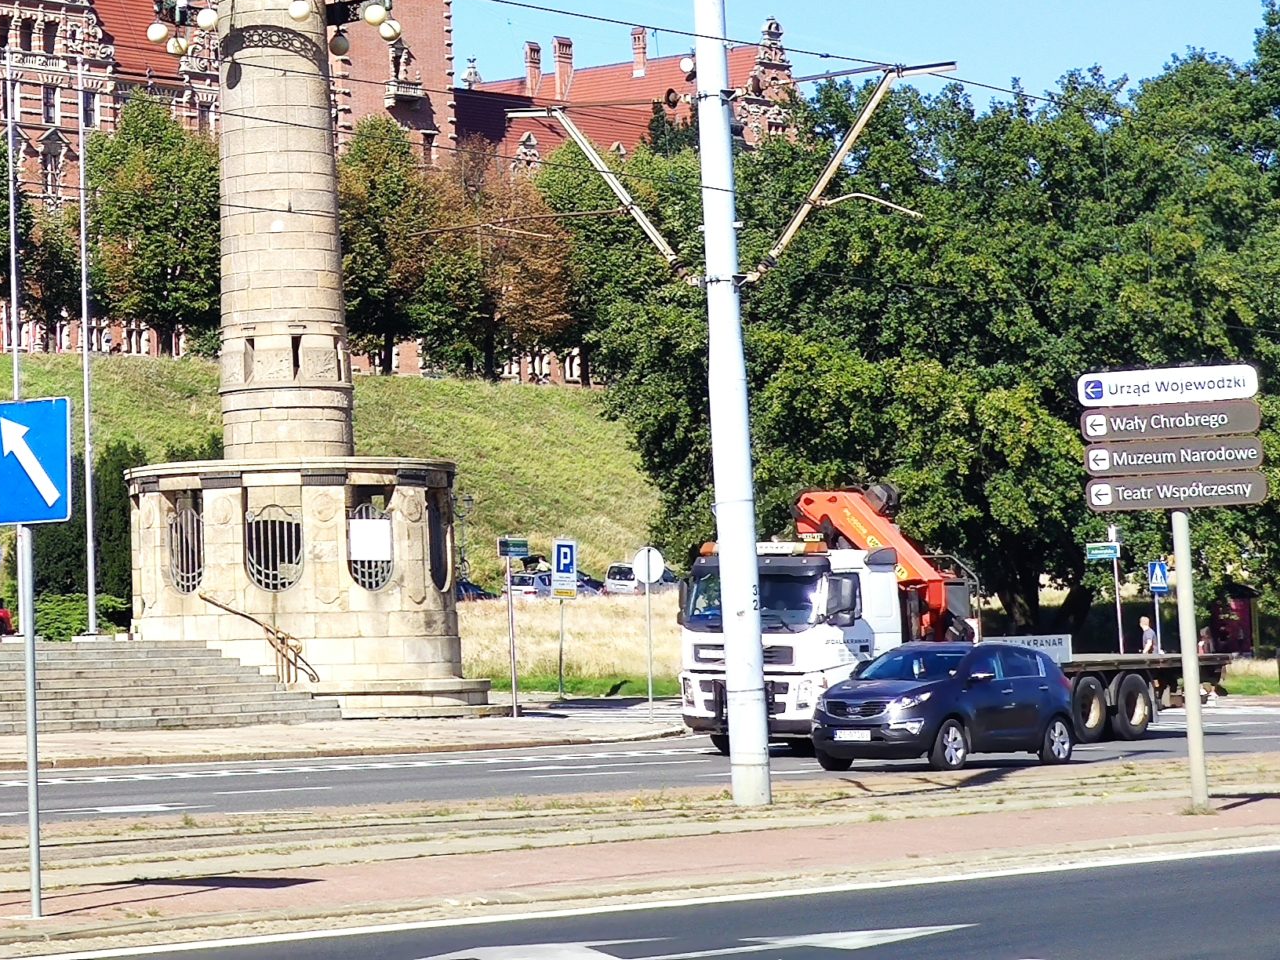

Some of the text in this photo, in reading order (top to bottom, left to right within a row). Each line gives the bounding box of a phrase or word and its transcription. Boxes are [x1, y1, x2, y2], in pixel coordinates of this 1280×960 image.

[1108, 381, 1150, 396] Urząd
[1110, 412, 1228, 433] Wały Chrobrego
[1112, 447, 1258, 466] Muzeum Narodowe
[1116, 482, 1252, 501] Teatr Współczesny
[560, 547, 570, 570] P
